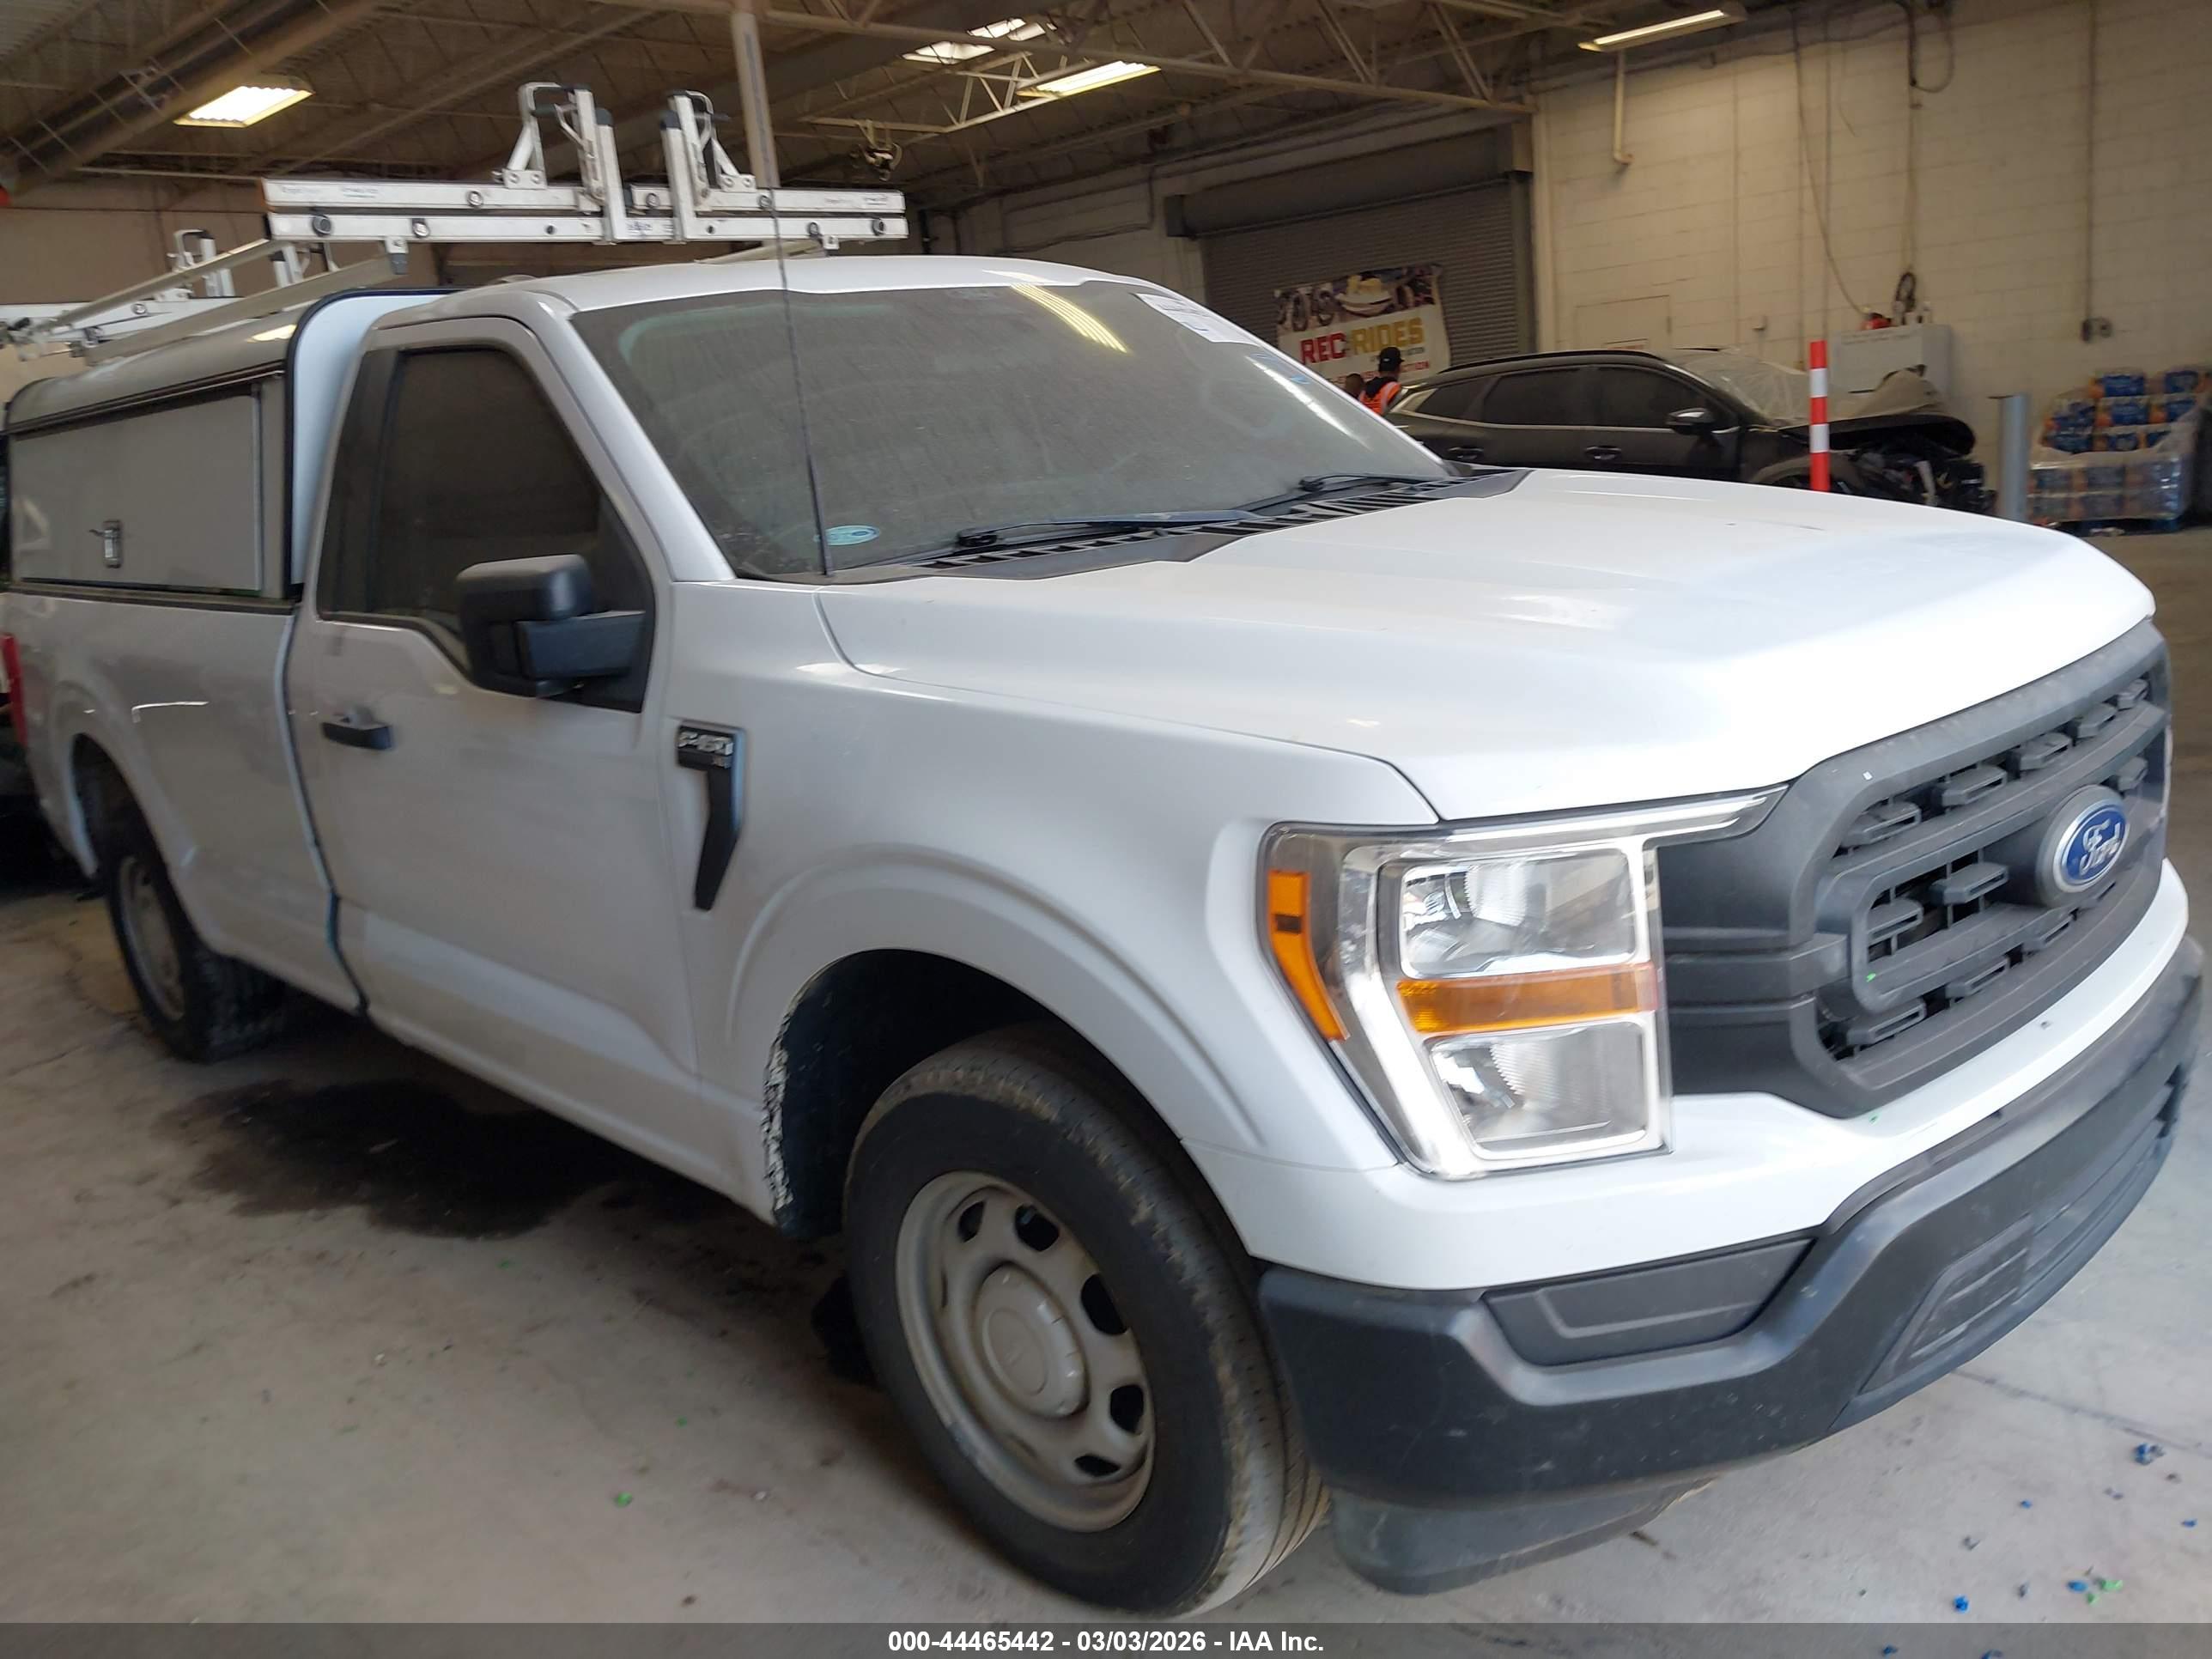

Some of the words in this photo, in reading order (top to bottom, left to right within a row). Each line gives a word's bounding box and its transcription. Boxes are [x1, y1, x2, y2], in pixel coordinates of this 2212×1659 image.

[1300, 331, 1346, 365] REC
[1352, 317, 1424, 355] RIDES
[2079, 818, 2122, 876] Ford
